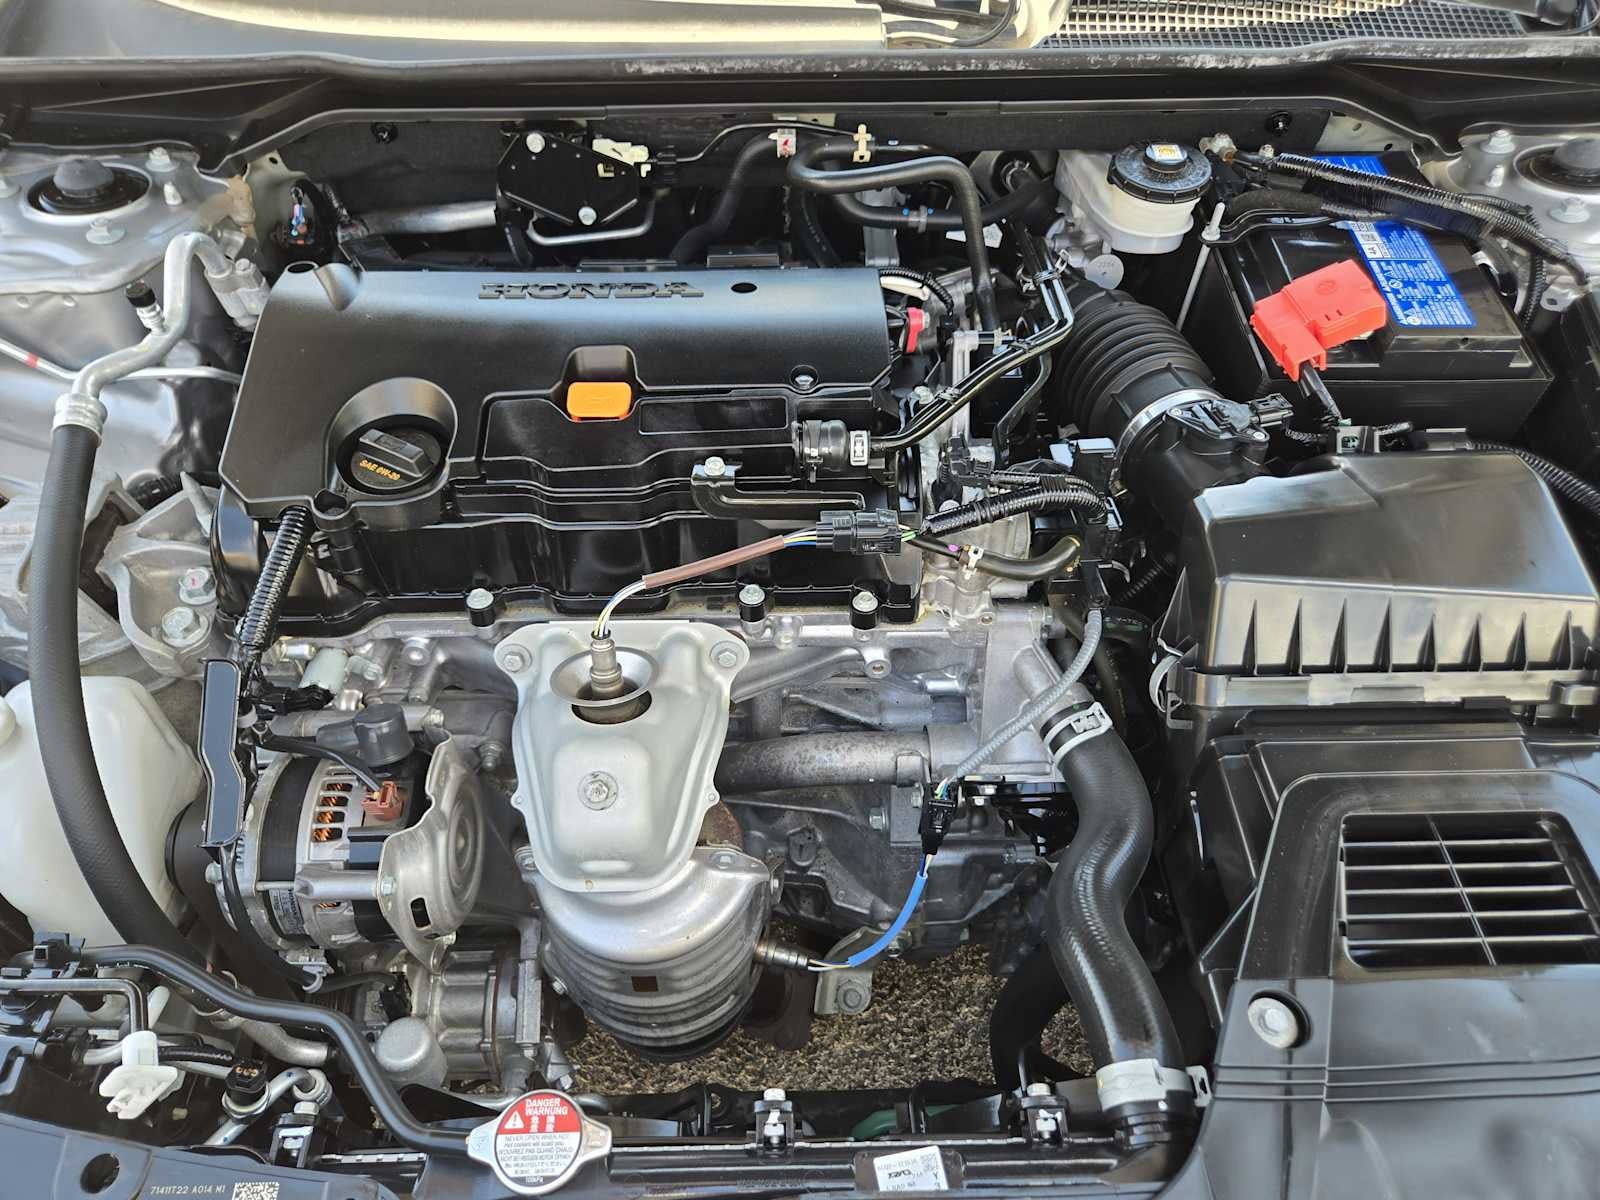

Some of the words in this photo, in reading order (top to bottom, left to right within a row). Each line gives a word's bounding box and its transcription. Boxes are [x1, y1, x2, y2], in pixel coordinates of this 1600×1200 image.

[479, 282, 704, 299] HONDA
[359, 459, 378, 472] SAE
[375, 466, 401, 481] 0W-20
[525, 1098, 561, 1107] DANGER
[525, 1106, 568, 1116] WARNUNG
